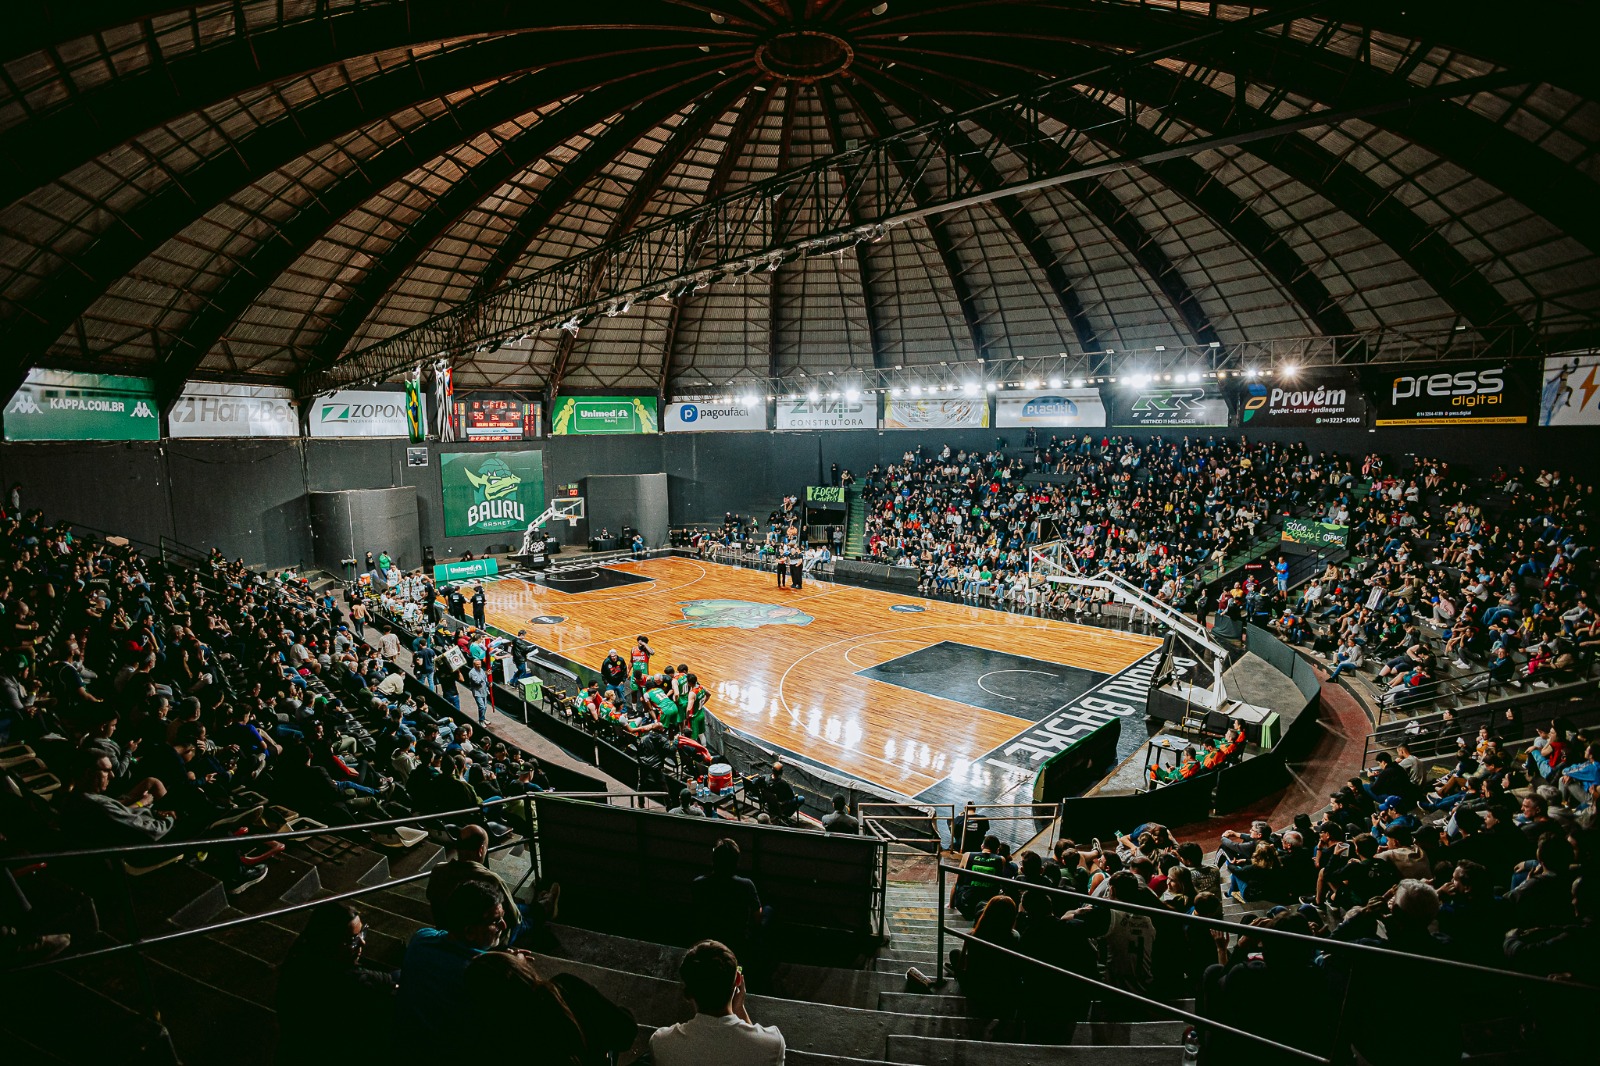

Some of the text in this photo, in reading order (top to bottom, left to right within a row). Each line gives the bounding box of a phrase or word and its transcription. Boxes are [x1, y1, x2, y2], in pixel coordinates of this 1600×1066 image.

[1392, 369, 1504, 406] press
[1269, 385, 1347, 407] Provém
[1451, 393, 1503, 407] digital
[50, 397, 125, 413] KAPPA.COM.BR
[350, 404, 407, 418] ZOPON
[580, 410, 616, 418] Unimed
[700, 407, 749, 419] pagoufácil
[790, 419, 864, 427] CONSTRUTORA
[467, 499, 525, 527] BAURU
[1286, 519, 1307, 532] SÓCIO
[450, 566, 474, 574] Unimed
